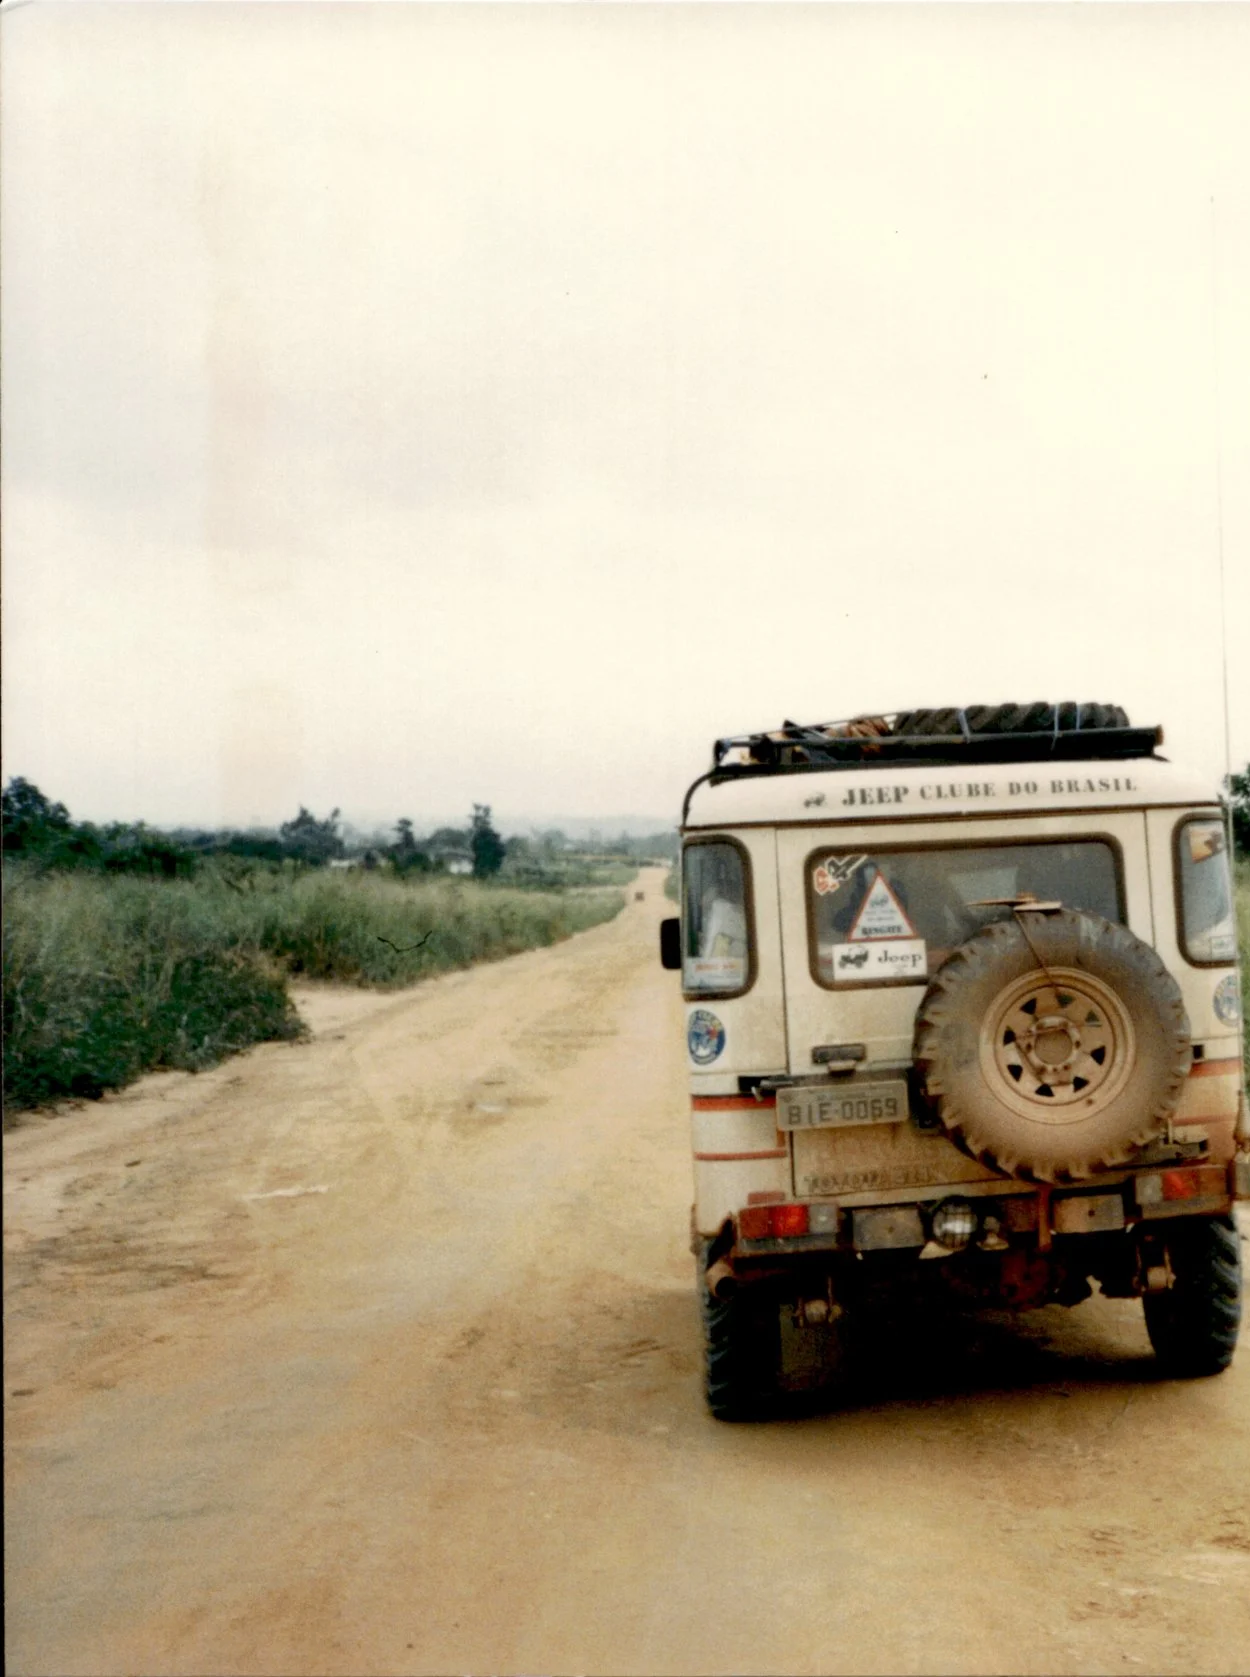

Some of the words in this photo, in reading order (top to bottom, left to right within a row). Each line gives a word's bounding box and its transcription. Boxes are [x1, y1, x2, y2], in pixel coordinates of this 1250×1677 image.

[842, 786, 909, 806] JEEP
[919, 783, 997, 801] CLUBE
[1008, 781, 1038, 796] DO
[1050, 778, 1137, 794] BRASIL
[877, 949, 922, 968] Jeep
[788, 1097, 898, 1125] BIE-0069
